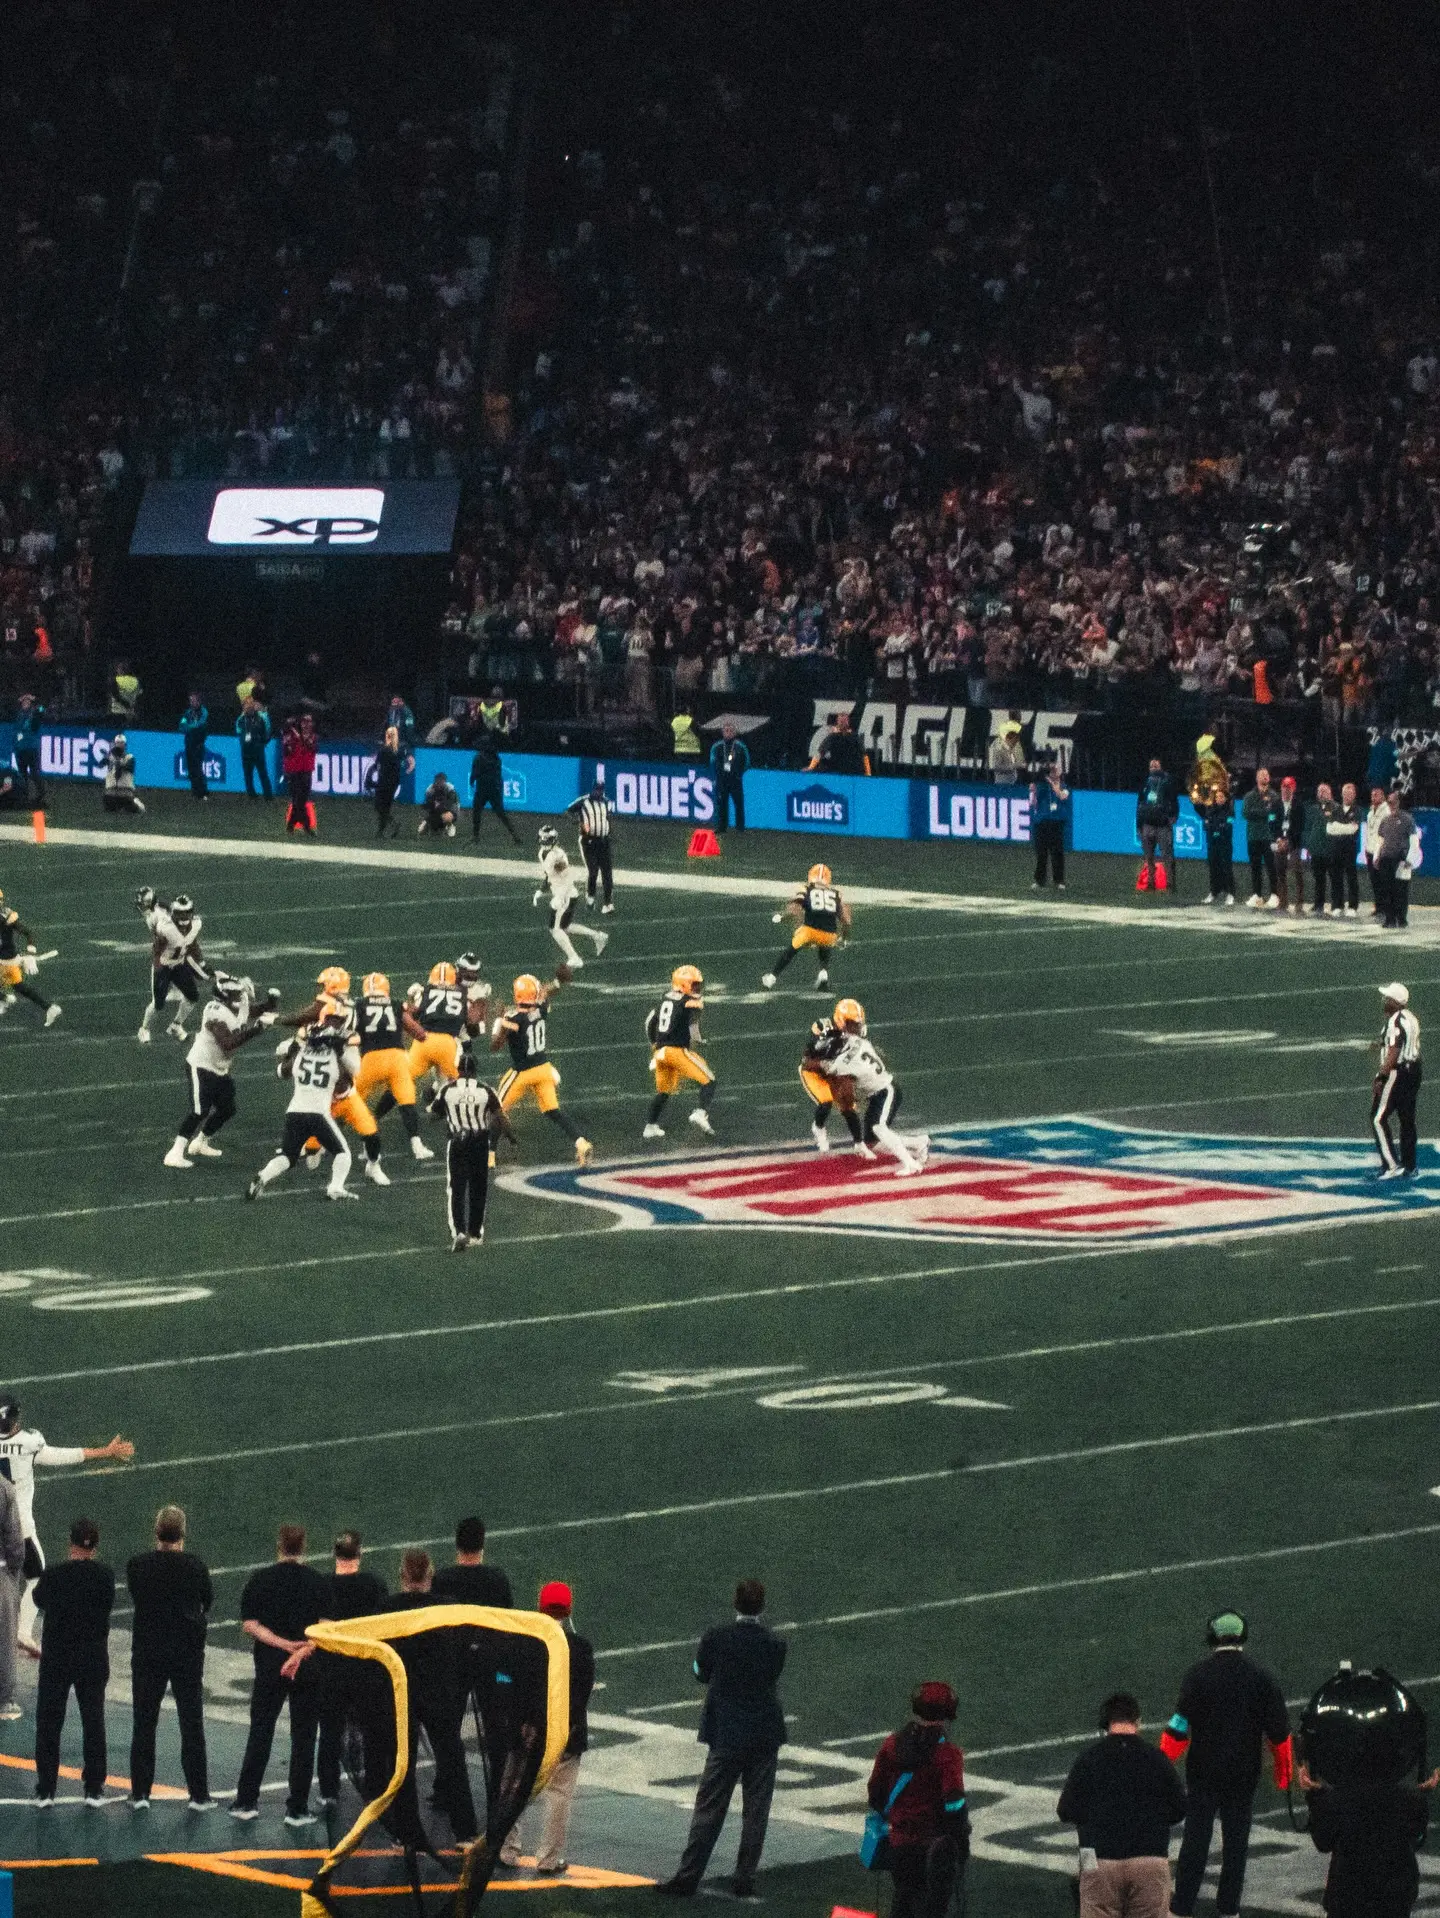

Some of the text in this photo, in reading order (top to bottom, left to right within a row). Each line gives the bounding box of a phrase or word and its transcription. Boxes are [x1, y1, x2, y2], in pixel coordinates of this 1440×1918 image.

[252, 517, 380, 544] xp
[40, 731, 110, 780] WE'S
[793, 797, 842, 821] LOWE'S
[929, 785, 1030, 841] LOWE
[810, 889, 837, 912] 85
[426, 989, 463, 1016] 75
[659, 1001, 674, 1033] 8
[365, 1006, 398, 1032] 71
[526, 1019, 546, 1056] 10
[298, 1057, 330, 1089] 55
